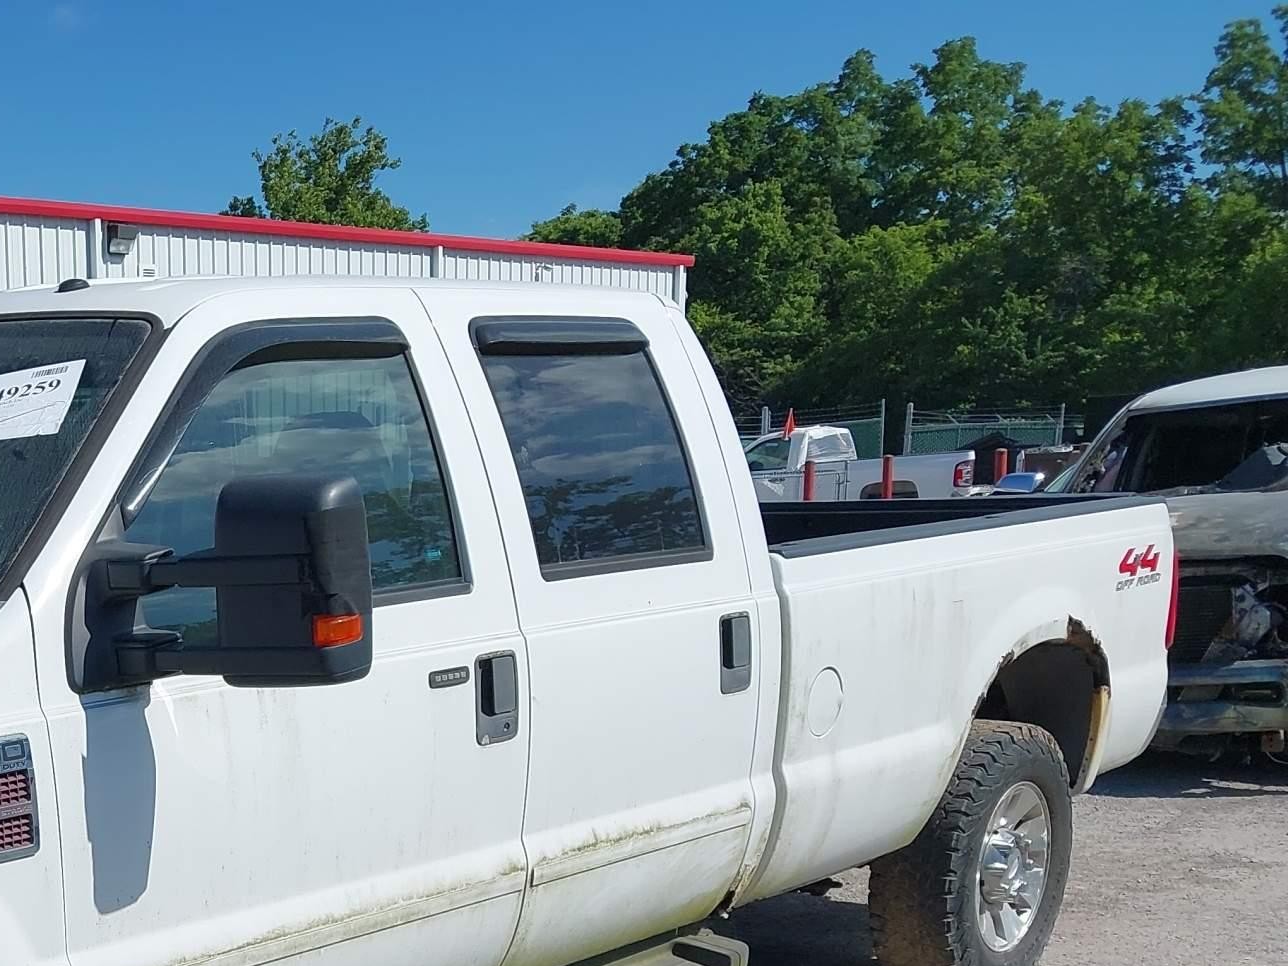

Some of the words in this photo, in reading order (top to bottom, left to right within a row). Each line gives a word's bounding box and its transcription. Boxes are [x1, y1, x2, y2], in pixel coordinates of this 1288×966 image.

[1118, 543, 1161, 577] 4x4
[1115, 578, 1135, 592] OFF
[1136, 572, 1162, 587] ROAD
[2, 760, 27, 771] DUTY
